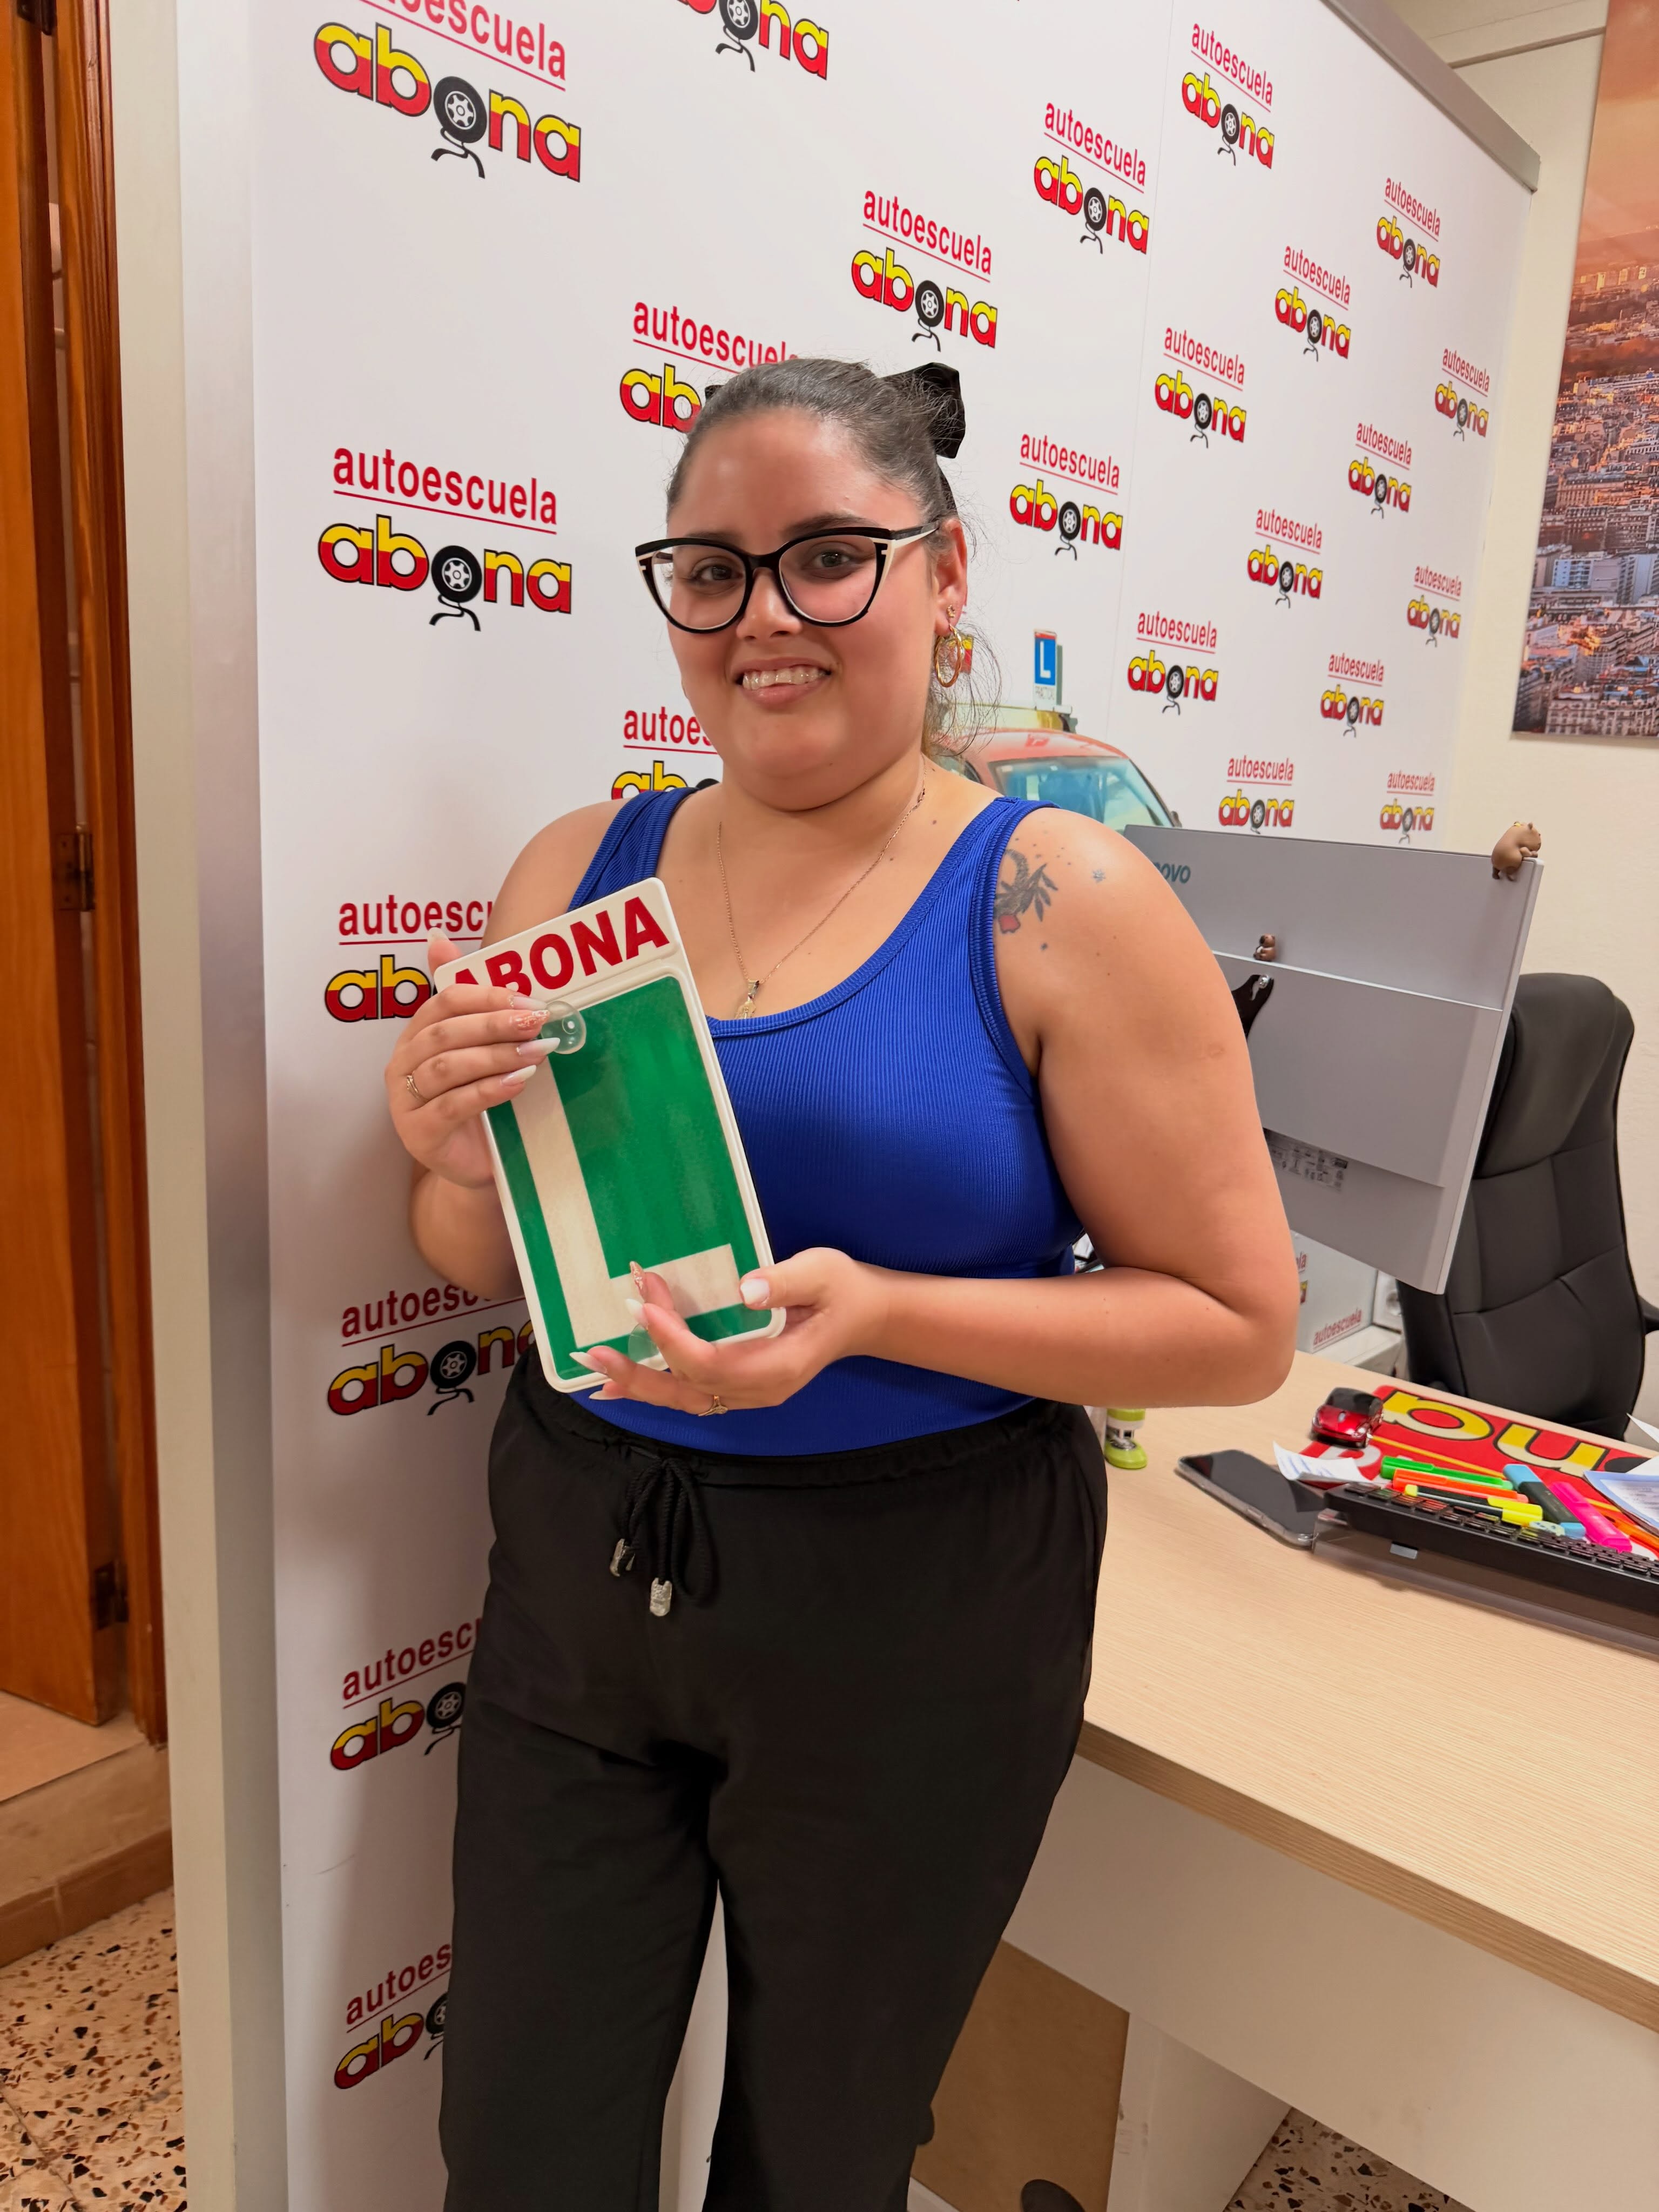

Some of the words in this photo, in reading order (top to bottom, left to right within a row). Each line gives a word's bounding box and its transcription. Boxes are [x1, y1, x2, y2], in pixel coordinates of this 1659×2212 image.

[388, 0, 565, 80] escuela
[1192, 24, 1272, 105] autoescuela
[314, 22, 581, 182] abona
[1182, 73, 1274, 168] abona
[1045, 103, 1145, 186] autoescuela
[864, 191, 991, 274] autoescuela
[1034, 156, 1149, 253] abona
[1385, 178, 1440, 235] autoescuela
[1284, 246, 1350, 304] autoescuela
[1377, 217, 1440, 287] abona
[851, 248, 997, 348] abona
[1275, 287, 1351, 359] abona
[1165, 328, 1244, 385] autoescuela
[1443, 349, 1489, 392] autoescuela
[1155, 370, 1246, 442] abona
[1435, 381, 1489, 436] abona
[1021, 434, 1119, 488] autoescuela
[1357, 423, 1411, 464] autoescuela
[333, 448, 556, 525] autoescuela
[1348, 457, 1411, 511] abona
[1009, 480, 1123, 550] abona
[1256, 510, 1321, 549] autoescuela
[318, 514, 571, 614] abona
[1247, 545, 1323, 598] abona
[1137, 612, 1217, 648] autoescuela
[1040, 640, 1051, 679] L
[1128, 650, 1218, 700] abona
[1329, 653, 1384, 681] autoescuela
[1320, 685, 1384, 725] abona
[1228, 755, 1293, 780] autoescuela
[1218, 790, 1294, 828] abona
[339, 894, 493, 936] autoesc
[342, 1284, 491, 1338] autoes
[1313, 1306, 1362, 1346] autoescuela
[342, 1618, 482, 1701] autoesc
[346, 1944, 451, 2025] autoes
